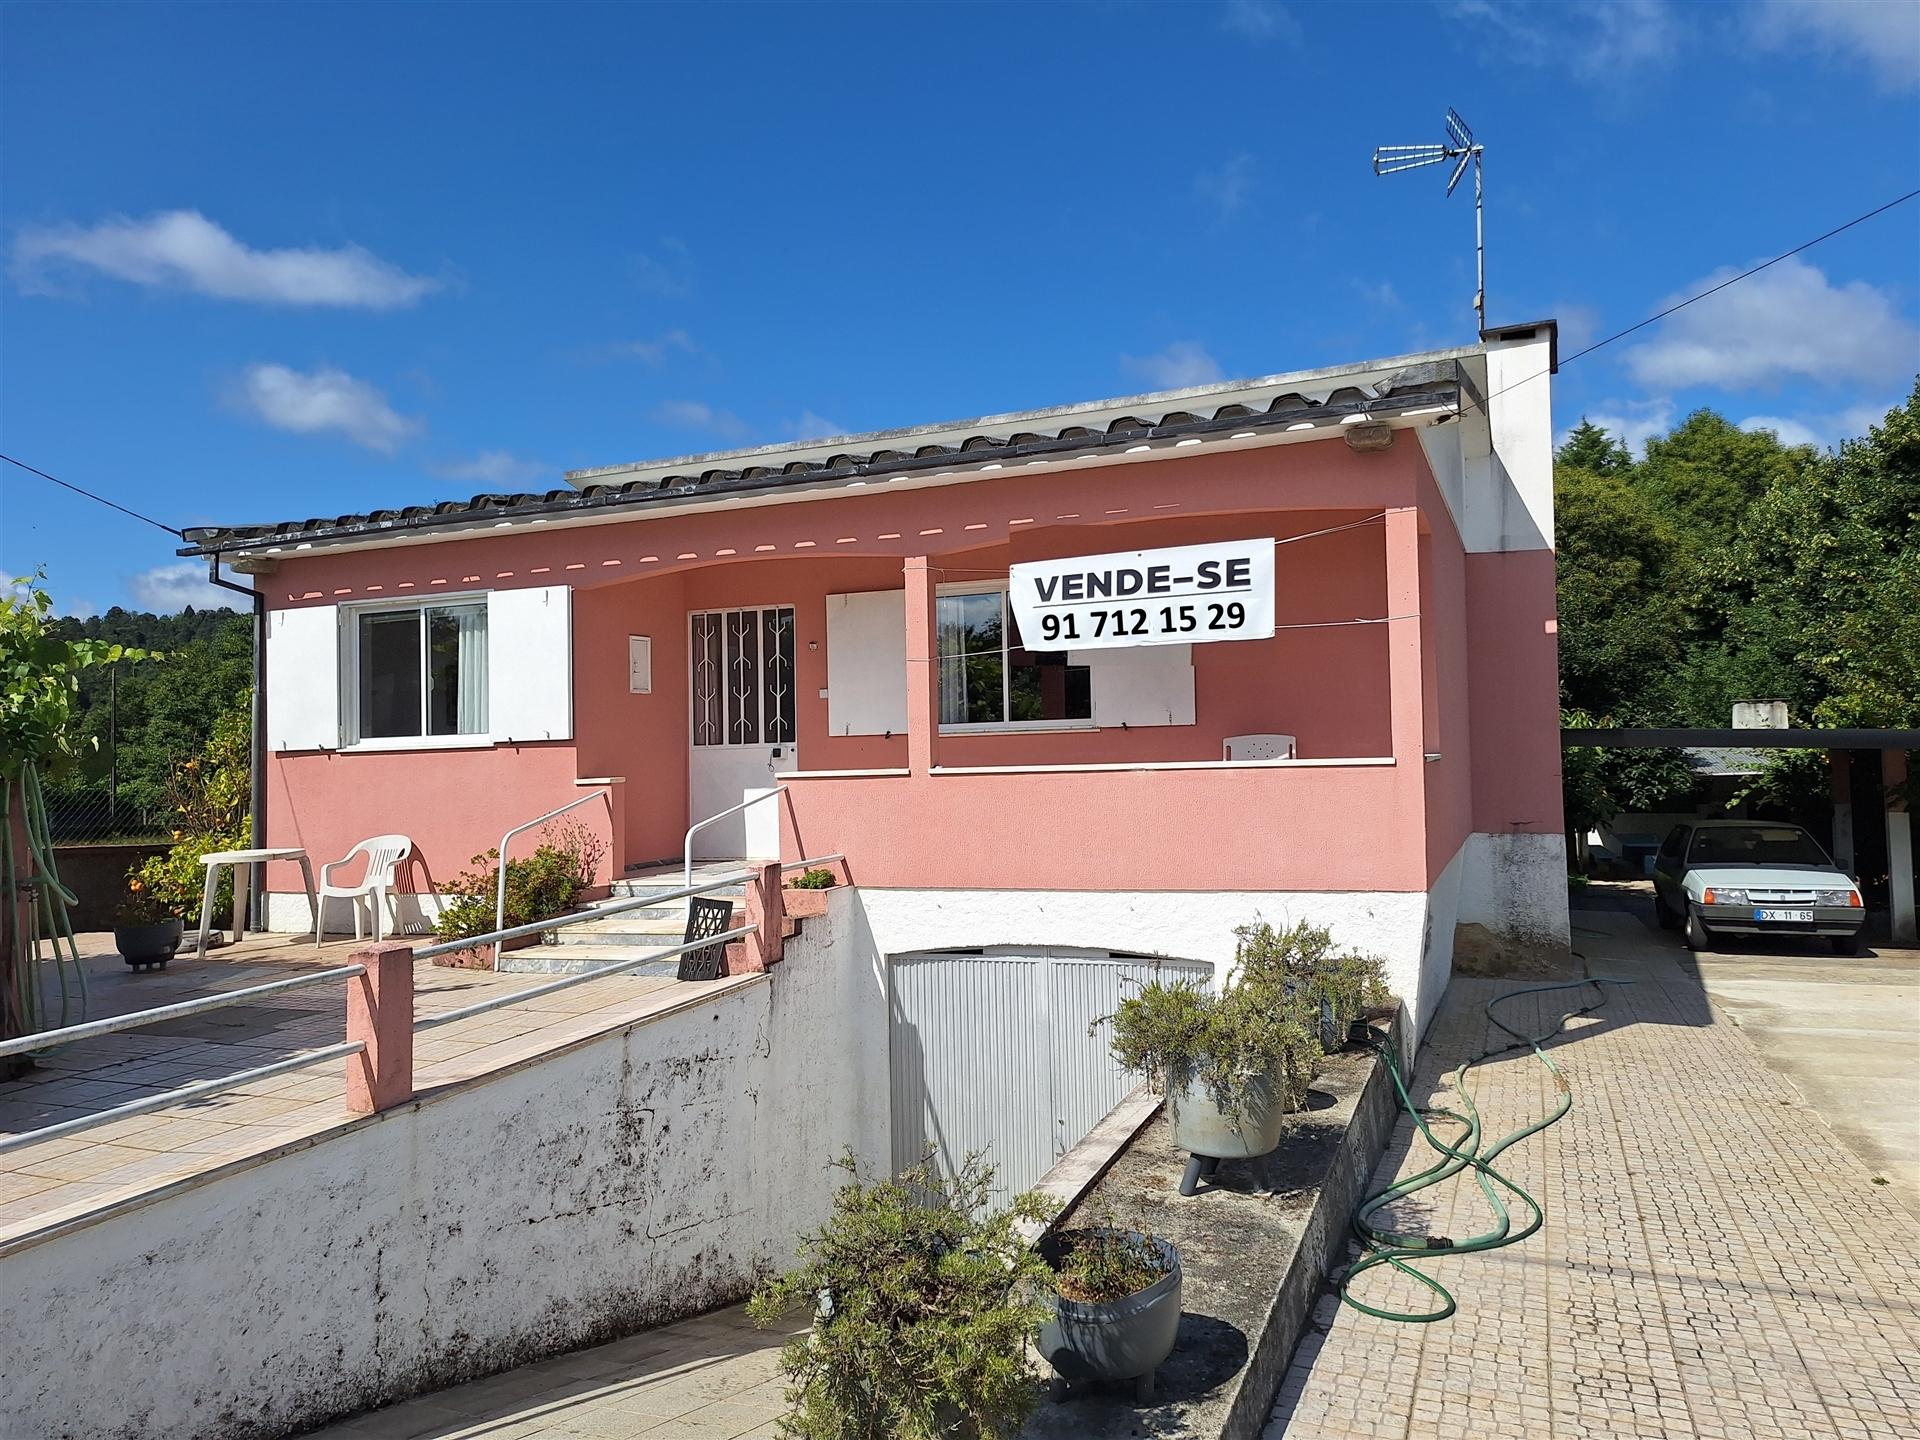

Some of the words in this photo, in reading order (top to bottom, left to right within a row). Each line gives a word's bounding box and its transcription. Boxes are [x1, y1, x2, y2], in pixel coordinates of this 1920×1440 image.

[1034, 558, 1251, 602] VENDE-SE
[1042, 613, 1081, 640] 91
[1090, 608, 1149, 638] 712
[1160, 606, 1197, 634] 15
[1207, 602, 1246, 630] 29
[1761, 911, 1776, 920] DX
[1784, 911, 1792, 920] 11
[1799, 911, 1813, 920] 65
